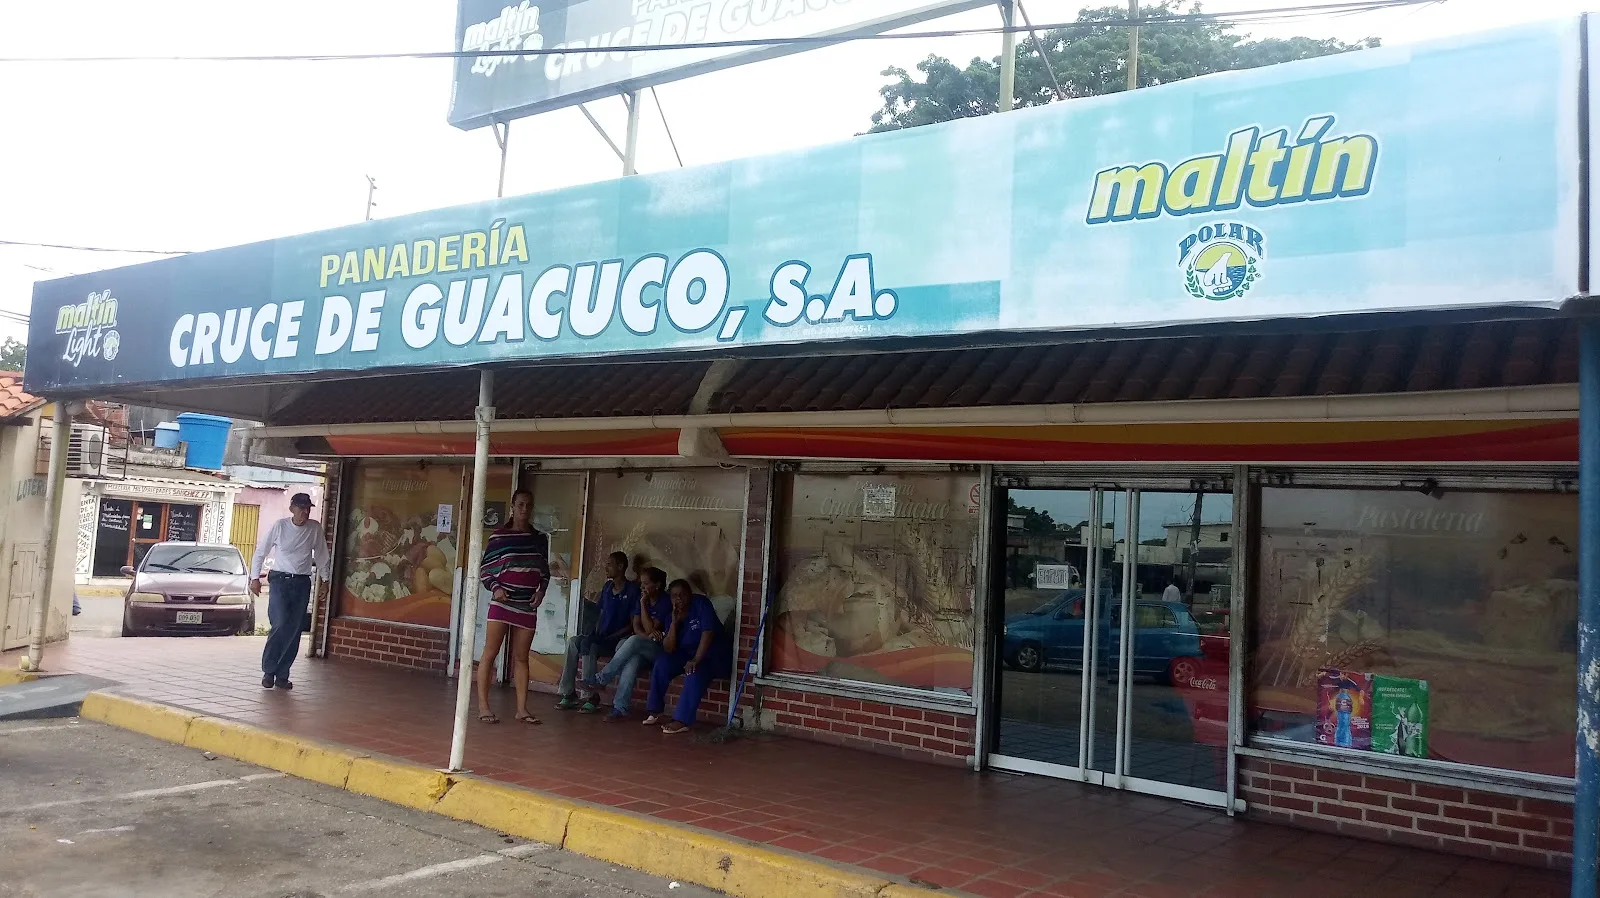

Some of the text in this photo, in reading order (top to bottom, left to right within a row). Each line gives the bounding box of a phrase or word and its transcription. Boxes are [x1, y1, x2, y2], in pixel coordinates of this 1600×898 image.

[1086, 115, 1378, 224] maltín
[319, 218, 529, 288] PANADERÍA
[1178, 222, 1264, 267] POLAR
[56, 289, 118, 334] maltín
[169, 247, 899, 367] CRUCE DE GUACUCO, S.A.
[62, 320, 102, 367] Light
